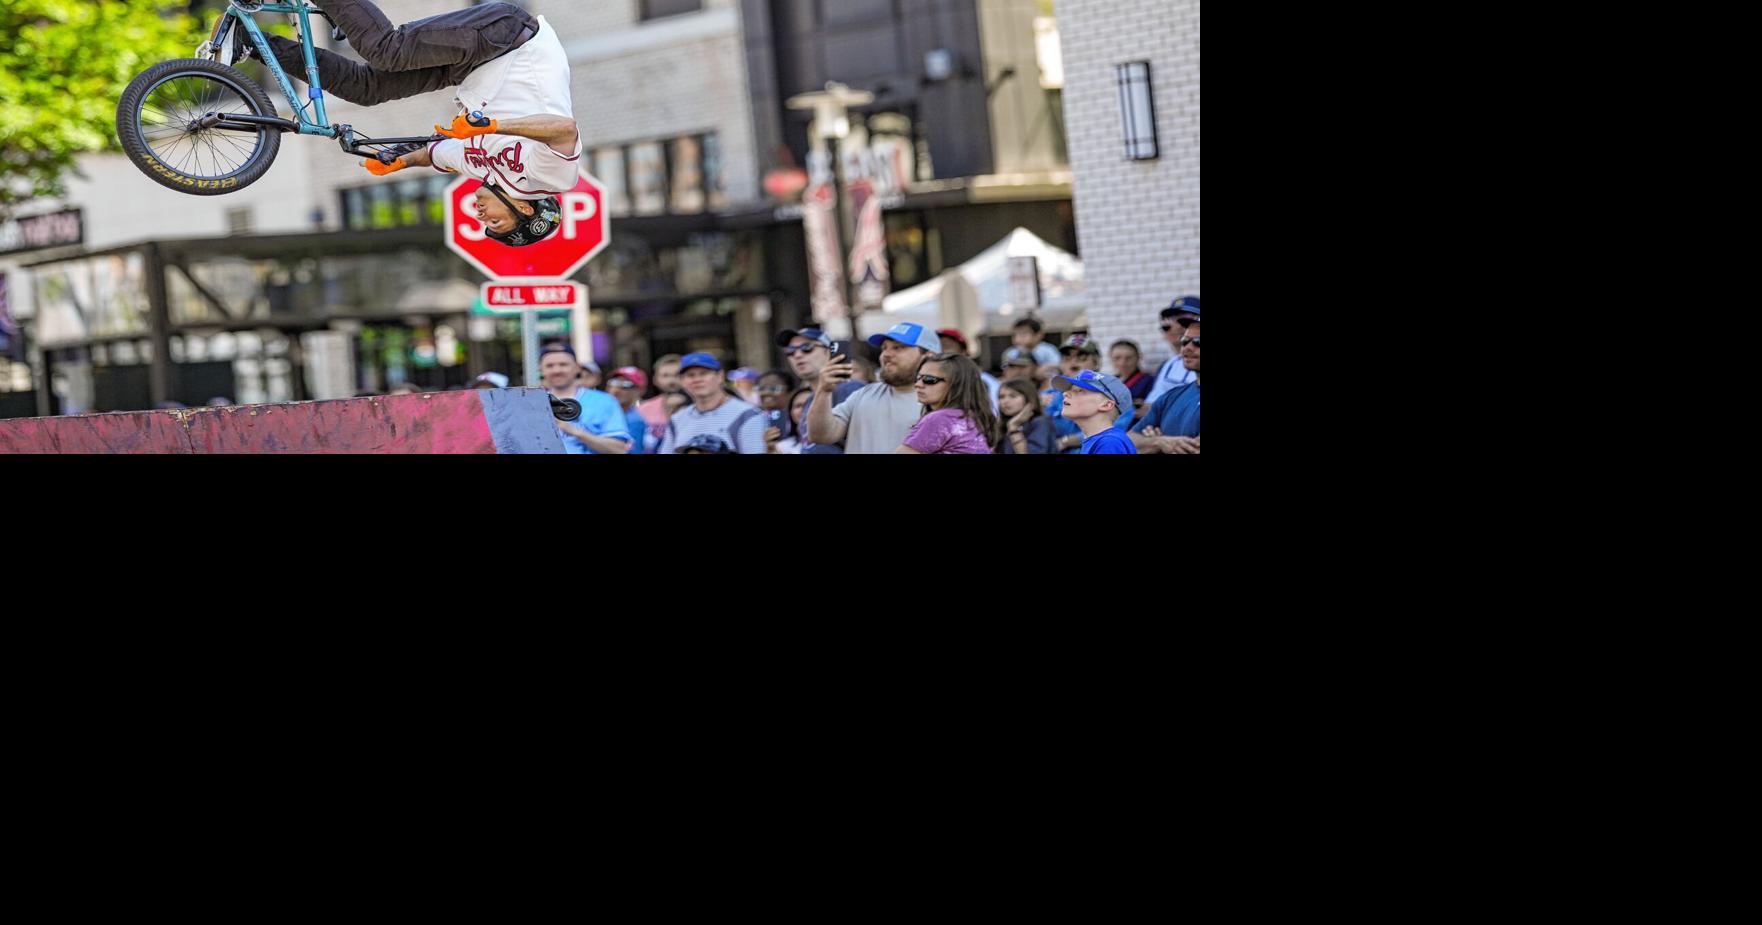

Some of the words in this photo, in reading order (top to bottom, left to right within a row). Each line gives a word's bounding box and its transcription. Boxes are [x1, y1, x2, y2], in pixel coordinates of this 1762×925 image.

[459, 192, 596, 240] SP
[491, 288, 525, 304] ALL
[532, 286, 570, 303] WAY
